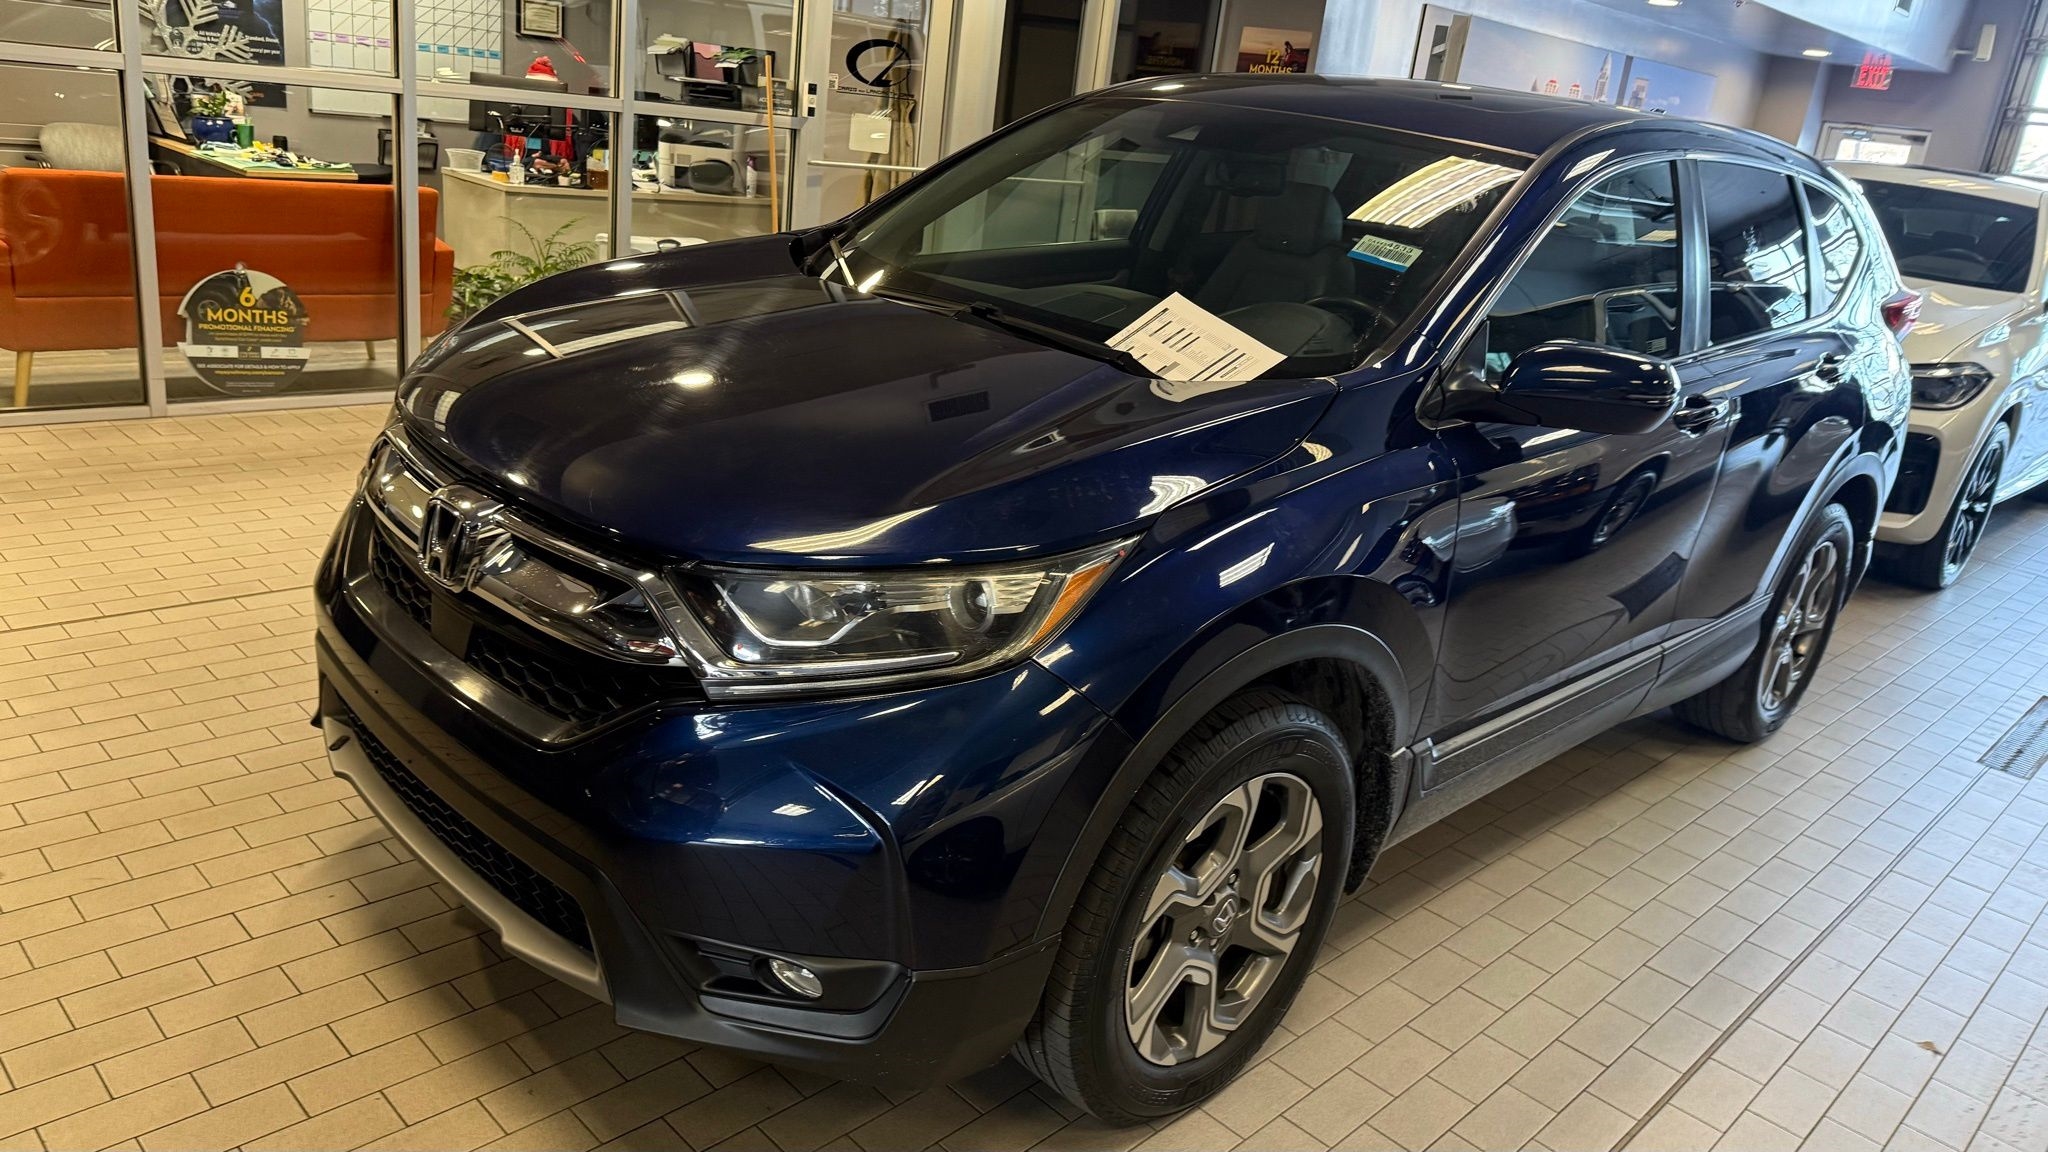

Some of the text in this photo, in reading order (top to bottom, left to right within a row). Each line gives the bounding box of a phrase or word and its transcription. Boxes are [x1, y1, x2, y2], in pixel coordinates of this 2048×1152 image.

[1265, 49, 1281, 64] 12
[1249, 64, 1293, 74] MONTHS
[239, 287, 256, 308] 6
[207, 308, 288, 324] MONTHS
[198, 323, 295, 333] PROMOTIONAL FINANCING
